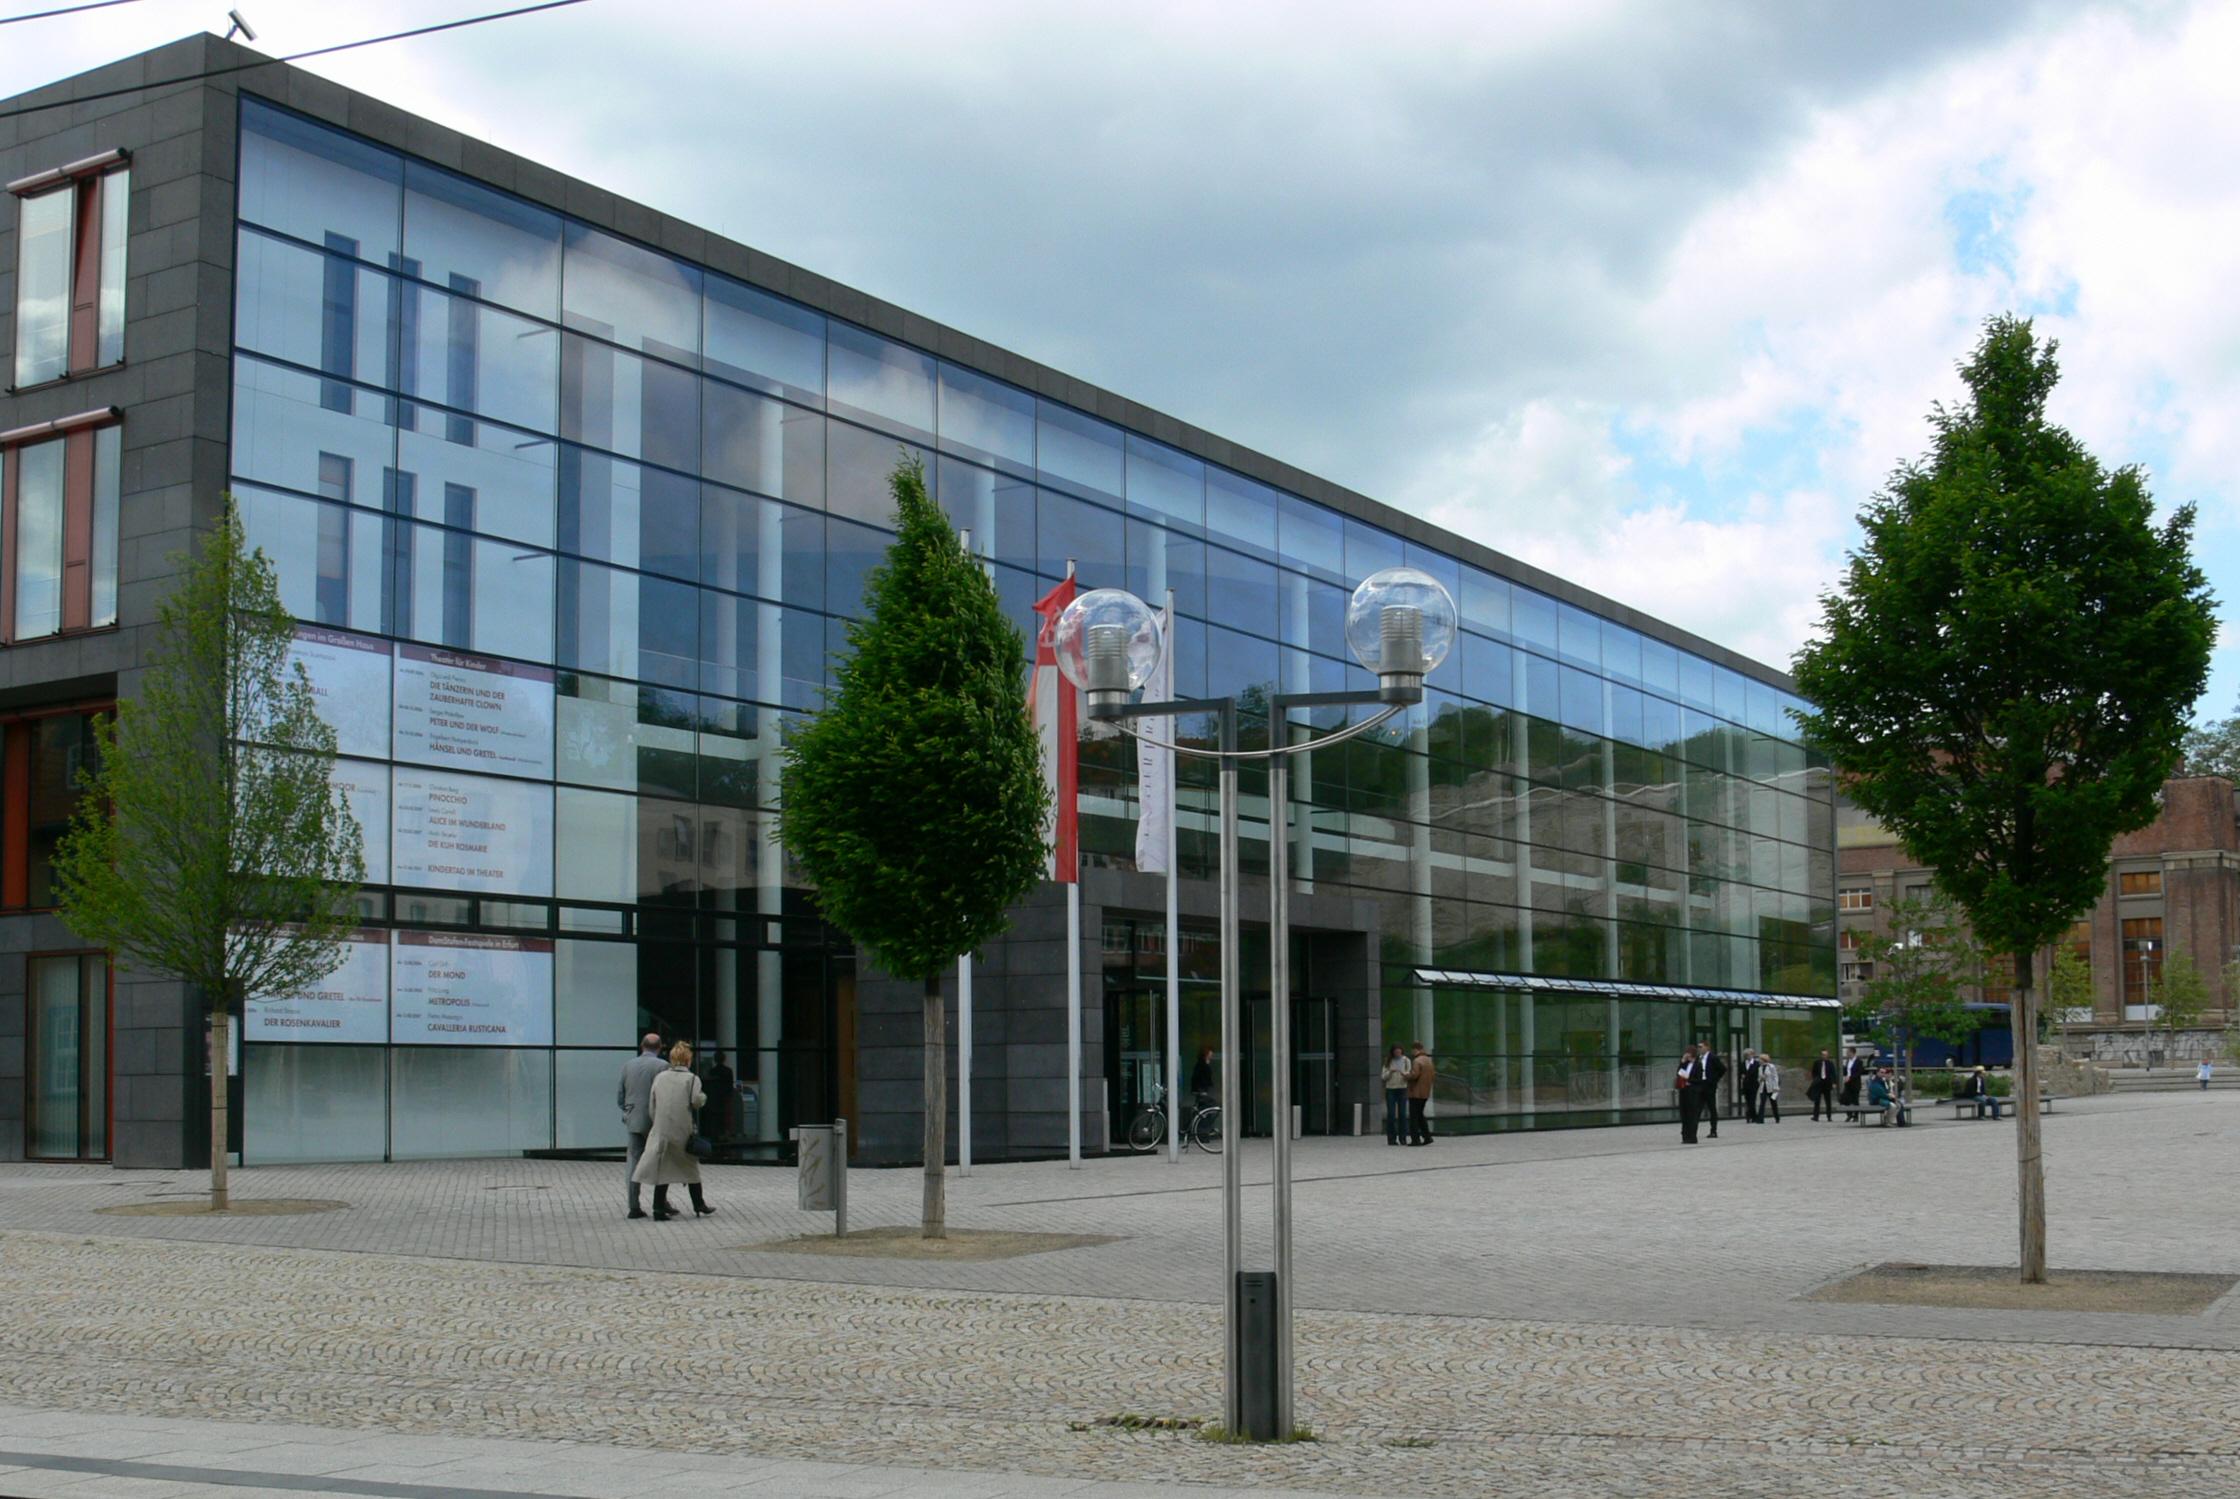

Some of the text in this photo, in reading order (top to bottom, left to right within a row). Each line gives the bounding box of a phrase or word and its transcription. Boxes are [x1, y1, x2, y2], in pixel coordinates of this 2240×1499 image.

[430, 681, 505, 700] DIE TÄNZERIN UND DER
[476, 701, 502, 711] CLOWN
[430, 717, 500, 734] PETER UND DER WOLF
[430, 742, 497, 759] HÄNSEL UND GRETEL
[429, 793, 467, 804] PINOCCHIO
[429, 817, 447, 825] ALICE
[459, 819, 506, 831] WUNDERLAND
[428, 840, 439, 848] DIE
[477, 869, 503, 878] THEATER
[428, 970, 441, 978] DER
[317, 992, 344, 1001] GRETEL
[428, 997, 470, 1006] METROPOLIS
[264, 1018, 341, 1029] DER ROSENKAVALIER
[427, 1024, 506, 1033] CAVALLERIA RUSTICANA
